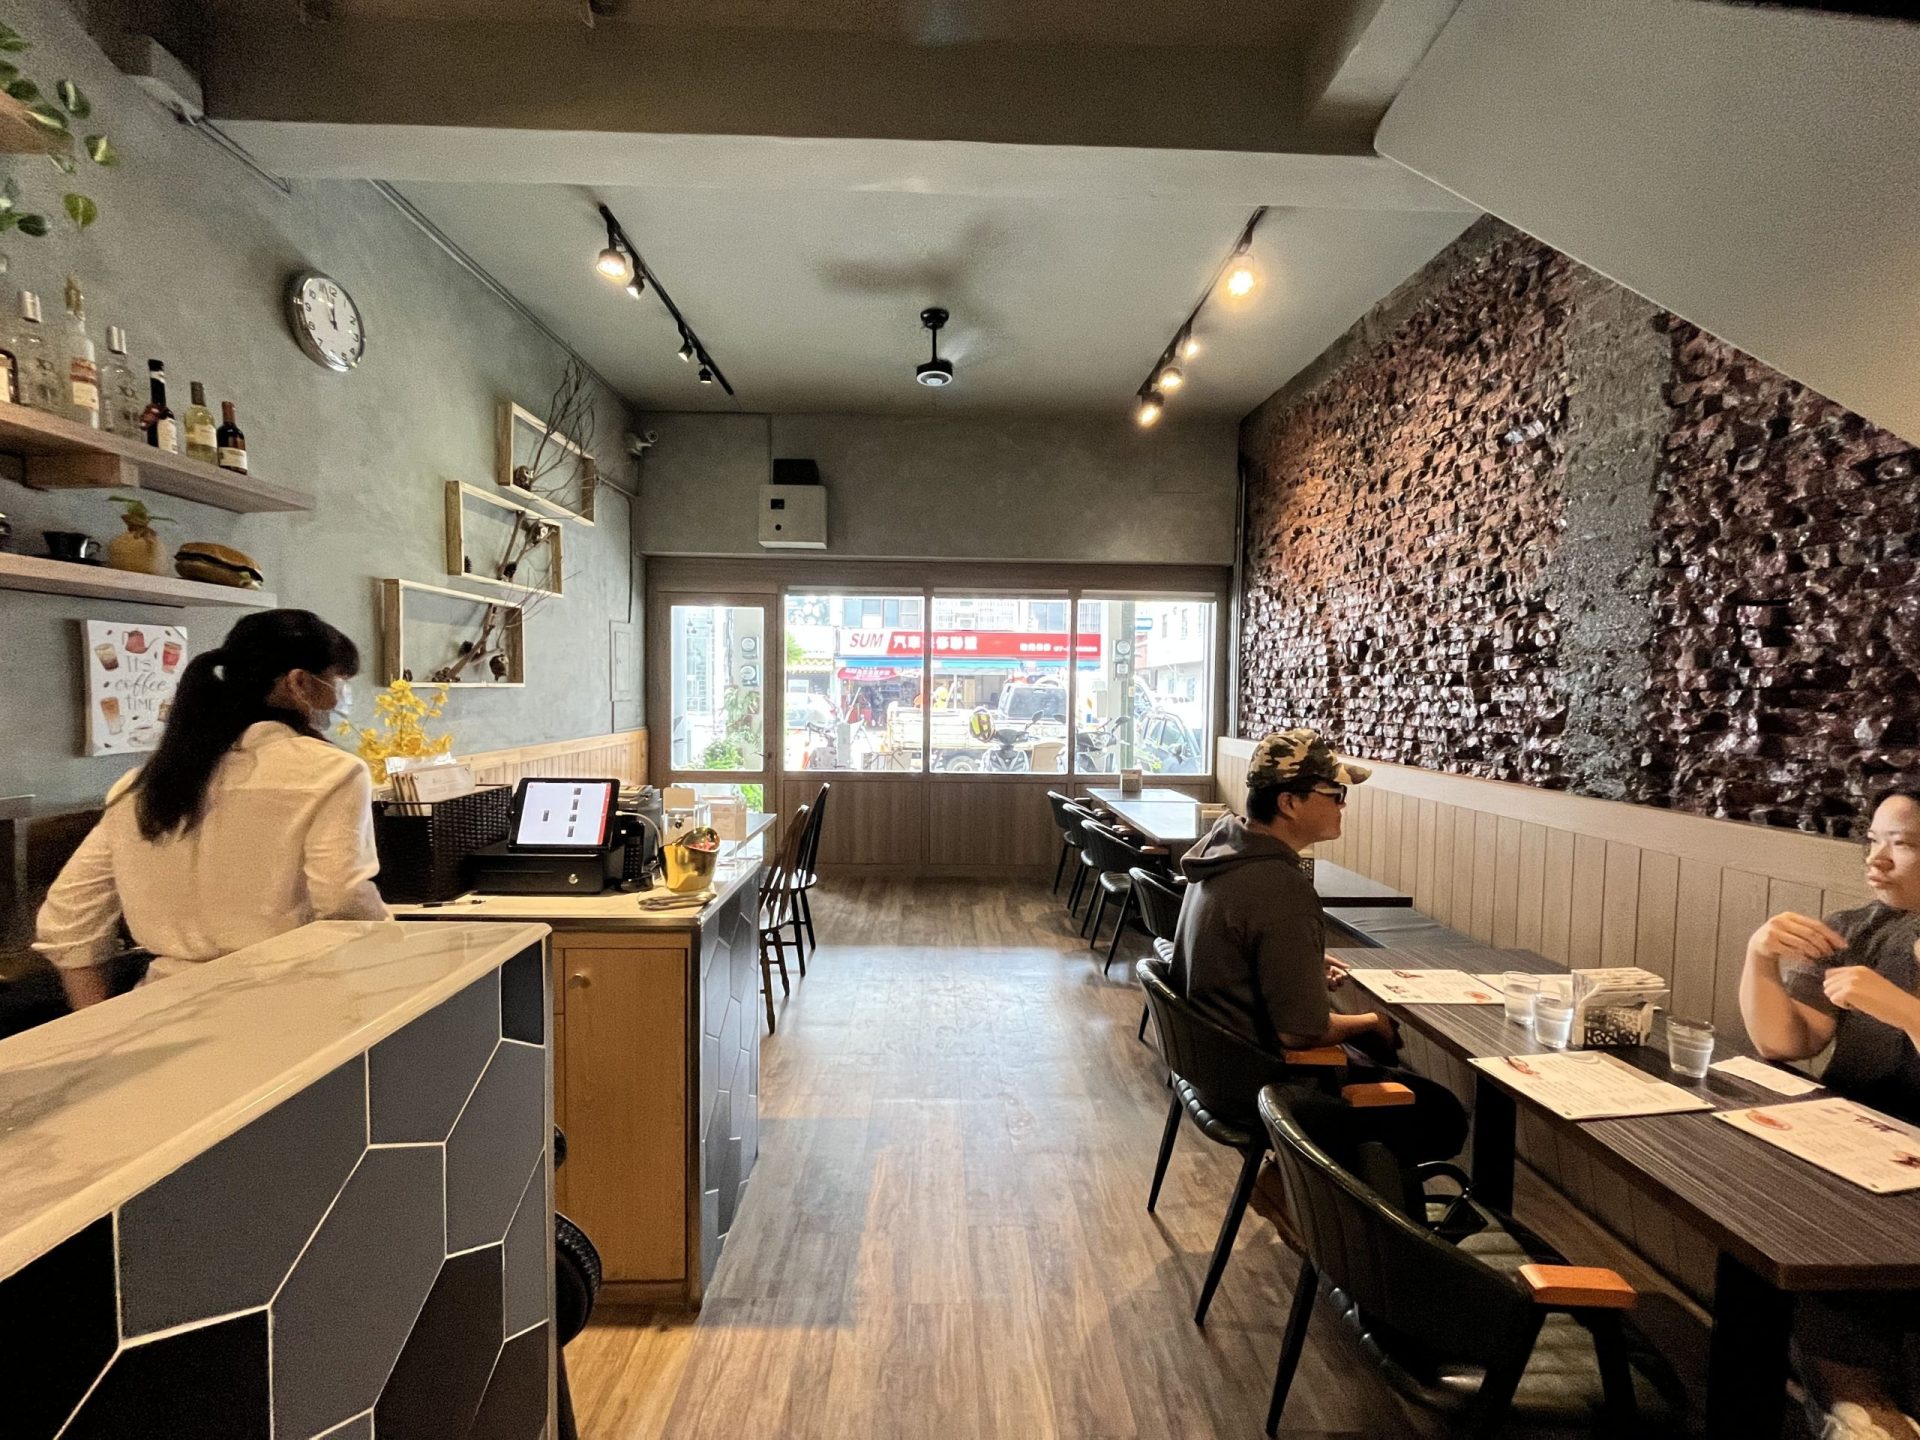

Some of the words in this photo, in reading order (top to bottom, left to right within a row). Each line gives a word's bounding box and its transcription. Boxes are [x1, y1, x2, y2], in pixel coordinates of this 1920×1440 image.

[329, 286, 338, 297] 12
[305, 303, 312, 312] 9
[350, 316, 356, 325] 2
[308, 321, 316, 330] 8
[318, 338, 324, 346] 7
[353, 334, 359, 343] 3
[342, 352, 348, 361] 5
[849, 632, 883, 648] SUM
[115, 671, 167, 697] coffee
